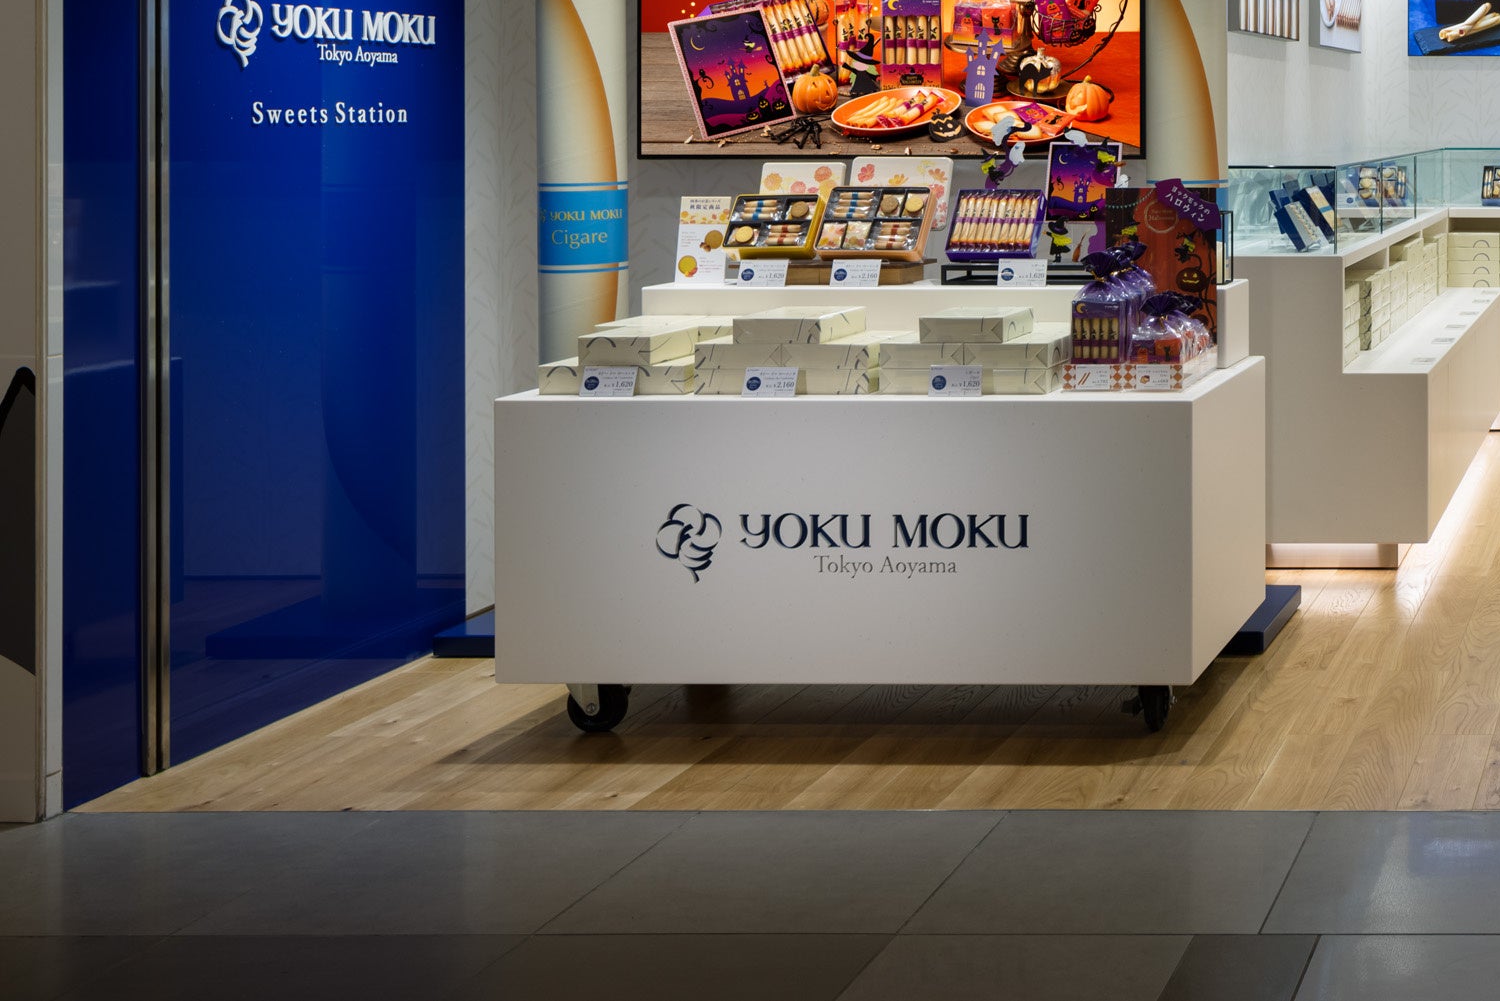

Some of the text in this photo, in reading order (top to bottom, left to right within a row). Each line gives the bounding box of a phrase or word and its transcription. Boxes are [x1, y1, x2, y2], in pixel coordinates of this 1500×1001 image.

[271, 3, 436, 45] YOKU MOKU
[317, 43, 399, 67] Tokyo Aoyama
[252, 101, 408, 125] Sweets Station
[550, 208, 623, 221] YOKU MOKU
[1164, 193, 1205, 222] ハロウィン
[551, 229, 608, 250] Cigare
[739, 512, 1030, 549] YOKU MOKU
[813, 554, 957, 579] Tokyo Aoyama
